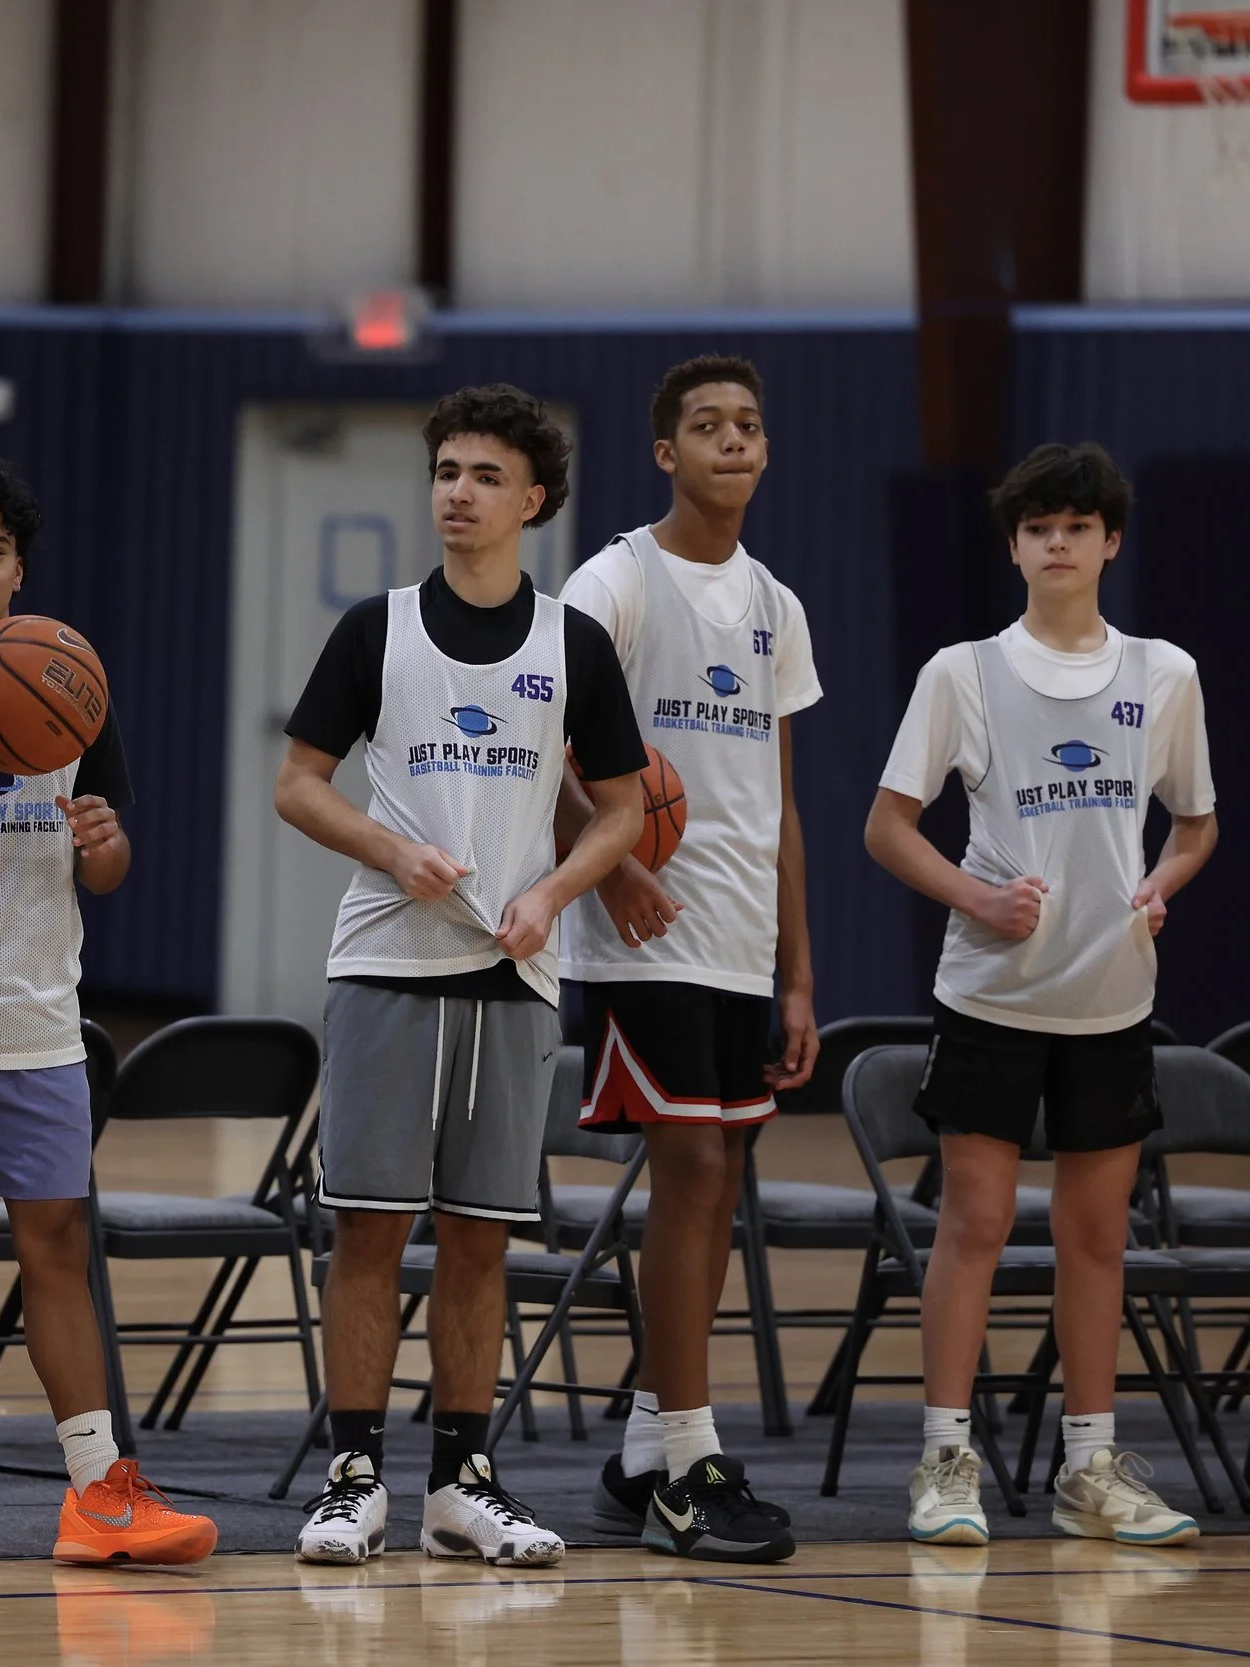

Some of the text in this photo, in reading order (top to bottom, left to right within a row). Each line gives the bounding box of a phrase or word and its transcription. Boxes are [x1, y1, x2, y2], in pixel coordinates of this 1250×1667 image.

[43, 657, 103, 724] ELITE
[511, 674, 554, 703] 455
[654, 698, 772, 731] JUST PLAY SPORTS
[1111, 701, 1145, 729] 437
[653, 717, 770, 742] BASKETBALL TRAINING FACILITY
[408, 743, 539, 770] JUST PLAY SPORTS
[409, 761, 536, 782] BASKETBALL TRAINING FACILITY
[1016, 779, 1133, 807] UST PLAY SPOR
[1018, 800, 1065, 819] ASKETBALL
[1069, 797, 1112, 809] TRAINING
